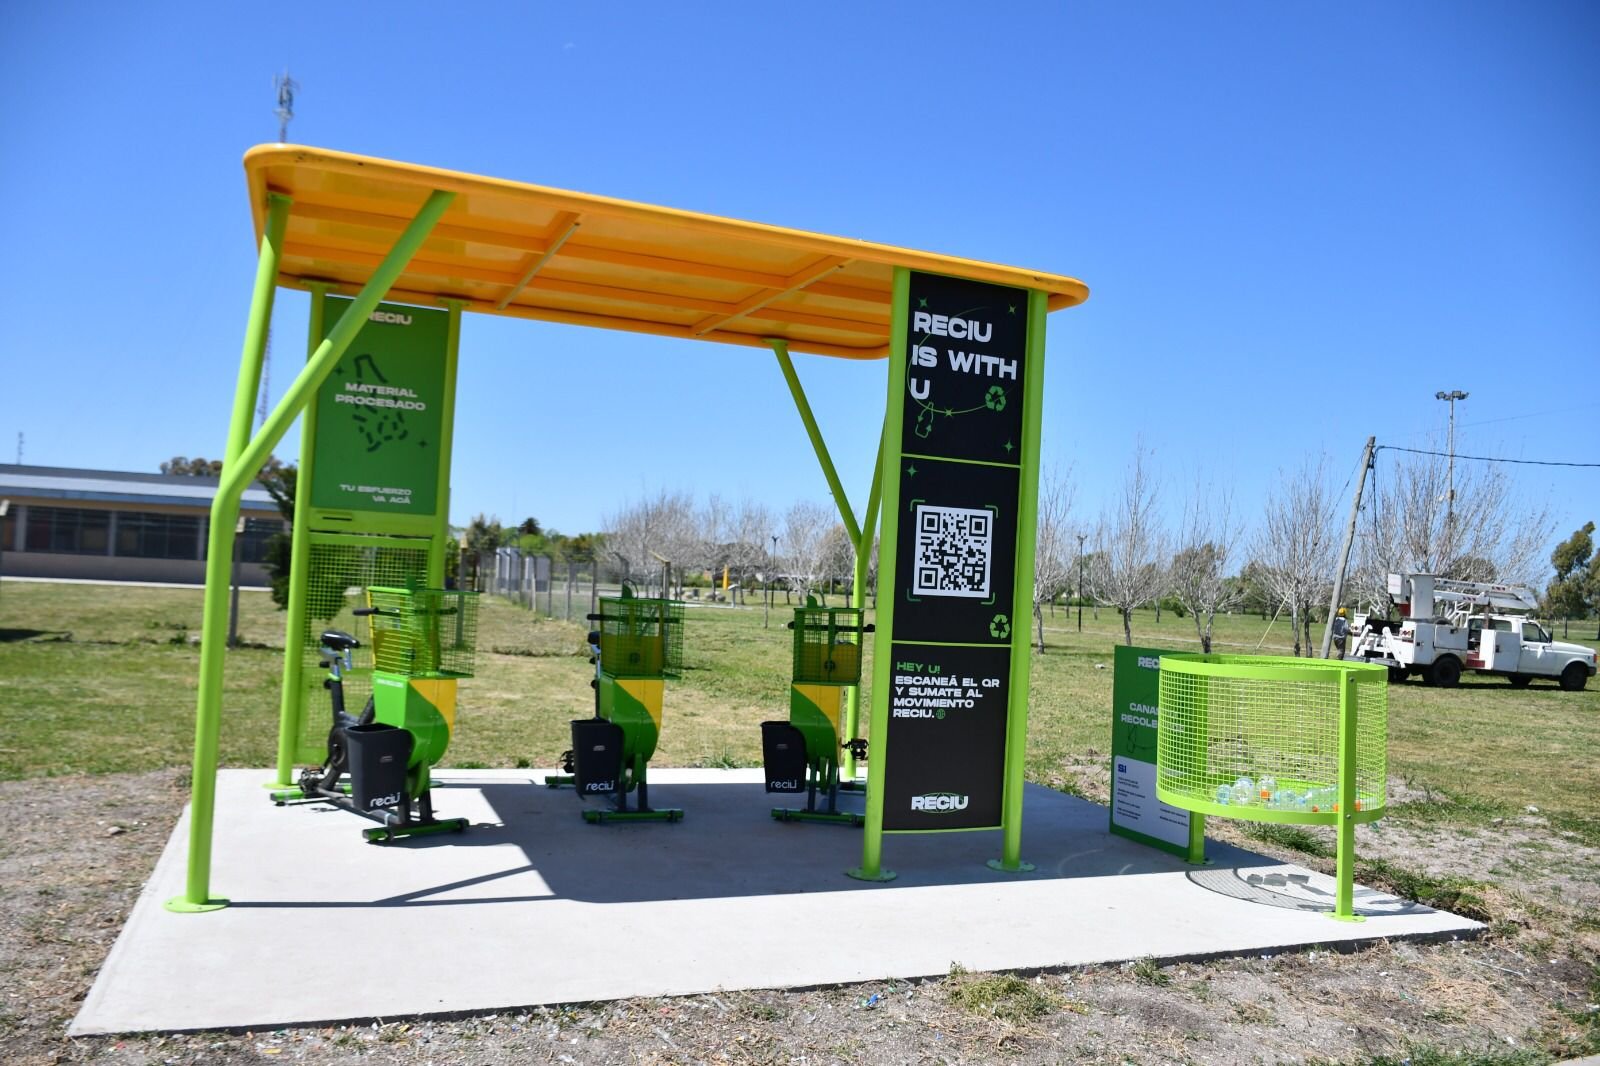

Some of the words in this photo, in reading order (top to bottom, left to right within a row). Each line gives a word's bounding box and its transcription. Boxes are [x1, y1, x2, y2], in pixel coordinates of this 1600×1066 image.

[913, 311, 993, 343] RECIU
[911, 344, 938, 368] IS
[948, 349, 1017, 380] WITH
[345, 382, 418, 398] MATERIAL
[910, 378, 931, 400] U
[335, 394, 426, 411] PROCESADO
[339, 484, 356, 492] TU
[357, 485, 412, 496] ESFUERZO
[896, 662, 924, 672] HEY
[928, 665, 941, 674] U!
[1137, 656, 1160, 669] REC
[895, 675, 958, 687] ESCANEÁ
[962, 677, 978, 687] EL
[982, 678, 1000, 688] QR
[895, 687, 904, 696] Y
[908, 687, 962, 698] SUMATE
[966, 688, 983, 698] AL
[893, 698, 975, 709] MOVIMIENTO
[892, 709, 935, 719] RECIU.
[911, 795, 969, 810] RECIU
